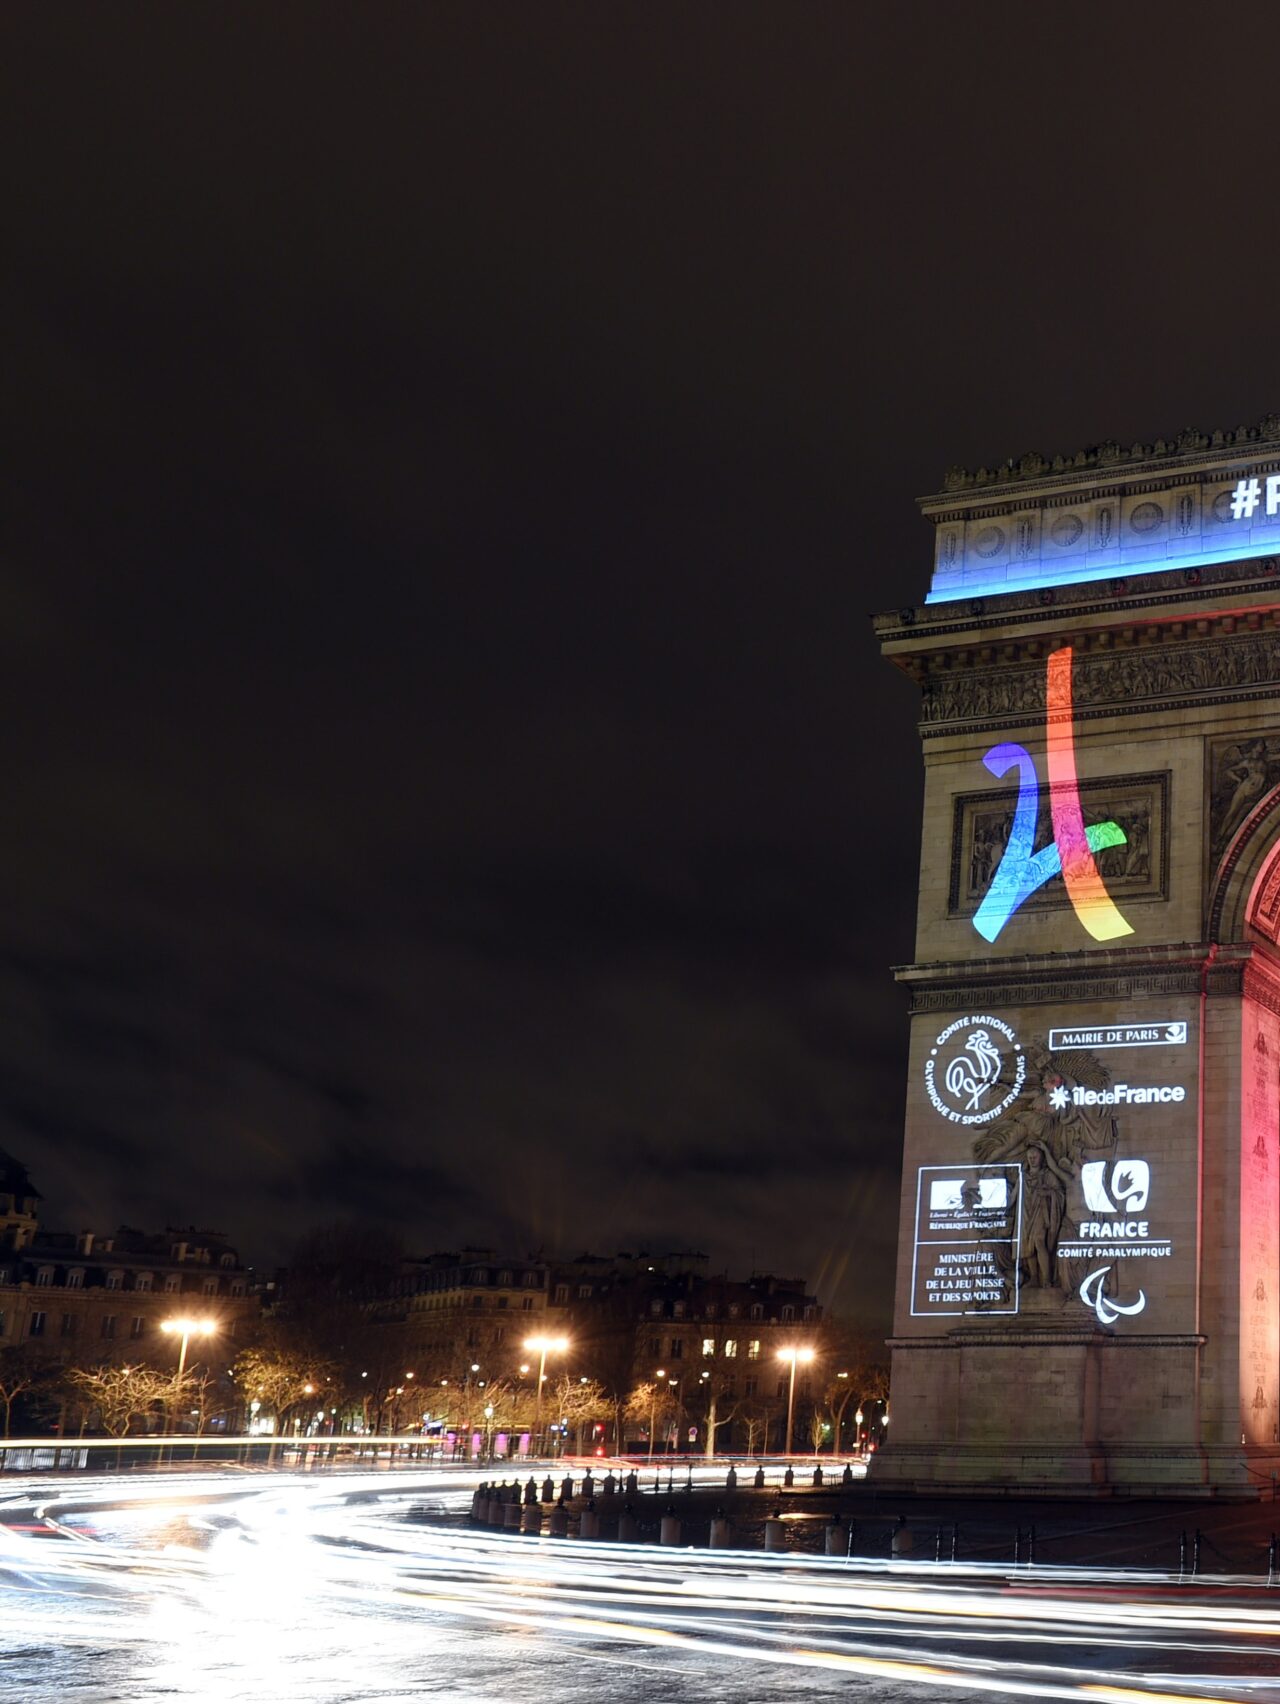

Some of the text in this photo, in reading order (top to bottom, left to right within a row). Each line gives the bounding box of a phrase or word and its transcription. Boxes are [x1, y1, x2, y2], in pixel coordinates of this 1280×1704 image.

[971, 1015, 1016, 1042] NATIONAL
[1061, 1029, 1159, 1044] MAIRIE DE PARIS
[925, 1060, 950, 1117] OLYMPIQUE
[948, 1111, 962, 1123] ET
[961, 1104, 1003, 1125] SPORTIF
[1079, 1221, 1149, 1238] FRANCE
[1057, 1247, 1172, 1258] COMITÉ PARALYMPIQUE
[934, 1267, 947, 1276] DE
[949, 1266, 962, 1276] LA
[926, 1280, 939, 1290] DE
[940, 1279, 954, 1289] LA
[929, 1292, 942, 1302] ET
[942, 1292, 961, 1302] DES
